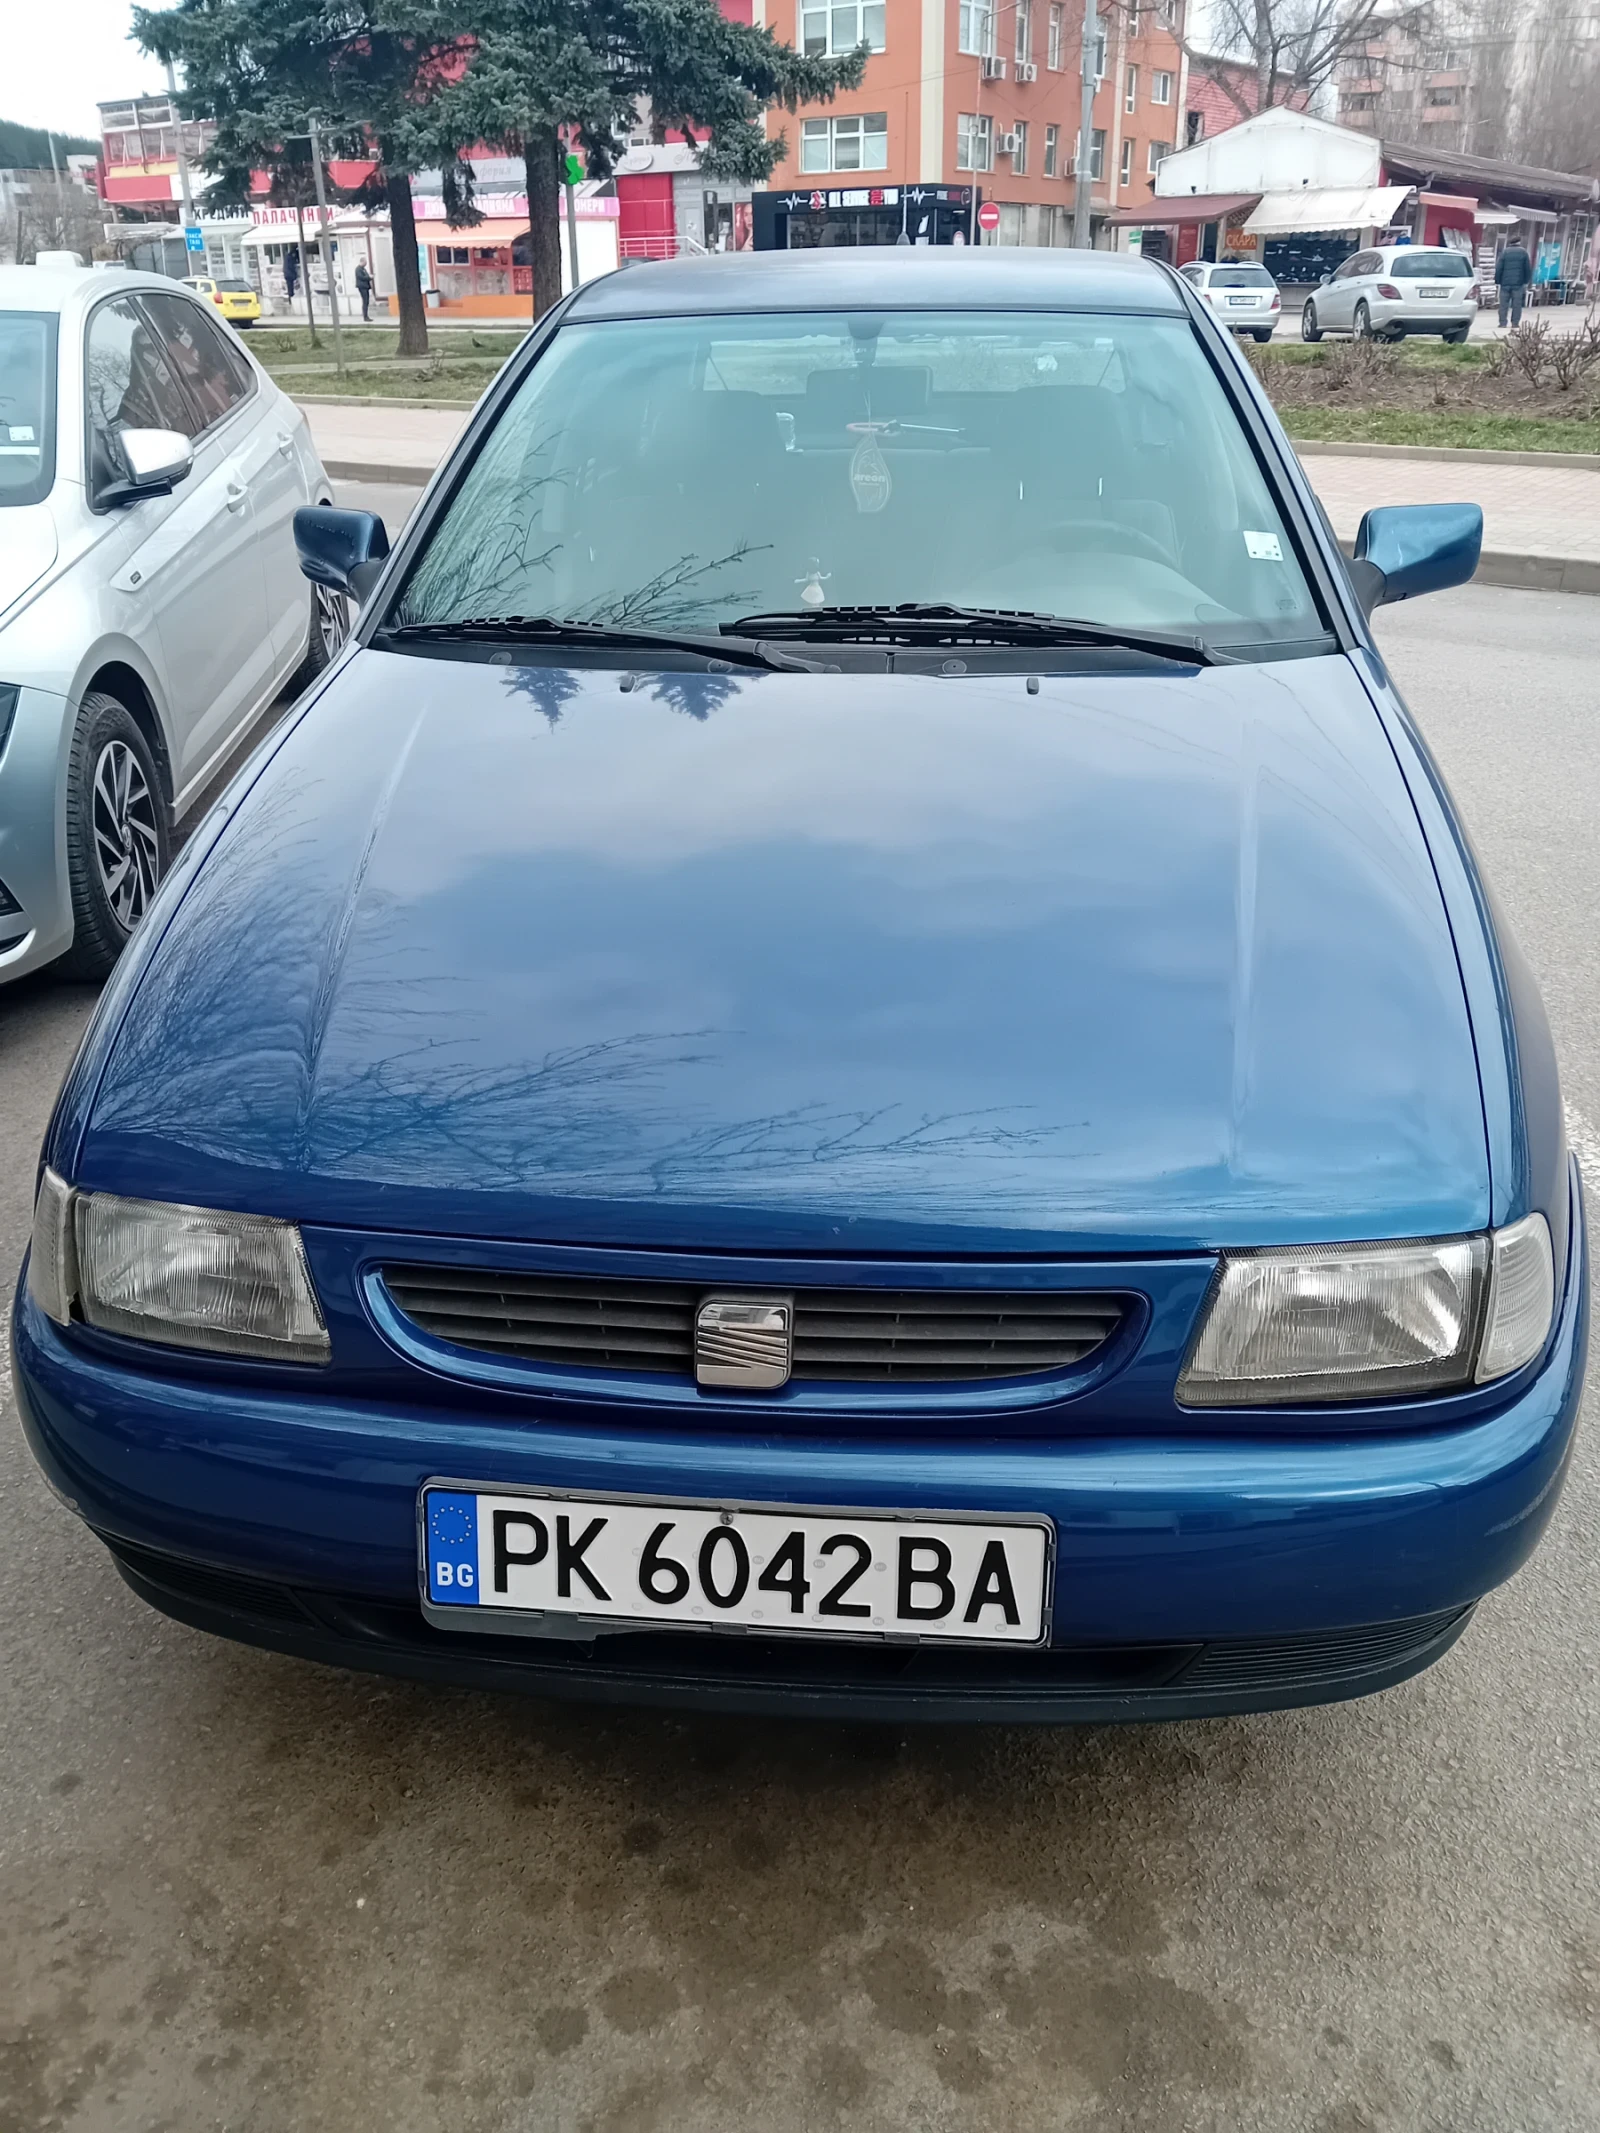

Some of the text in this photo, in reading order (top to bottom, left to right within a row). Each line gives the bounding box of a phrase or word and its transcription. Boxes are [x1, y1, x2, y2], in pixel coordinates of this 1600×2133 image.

[1226, 234, 1256, 246] СКАРА
[853, 474, 886, 482] areon
[436, 1561, 474, 1588] BG
[493, 1510, 1022, 1627] PK 6042 BA
